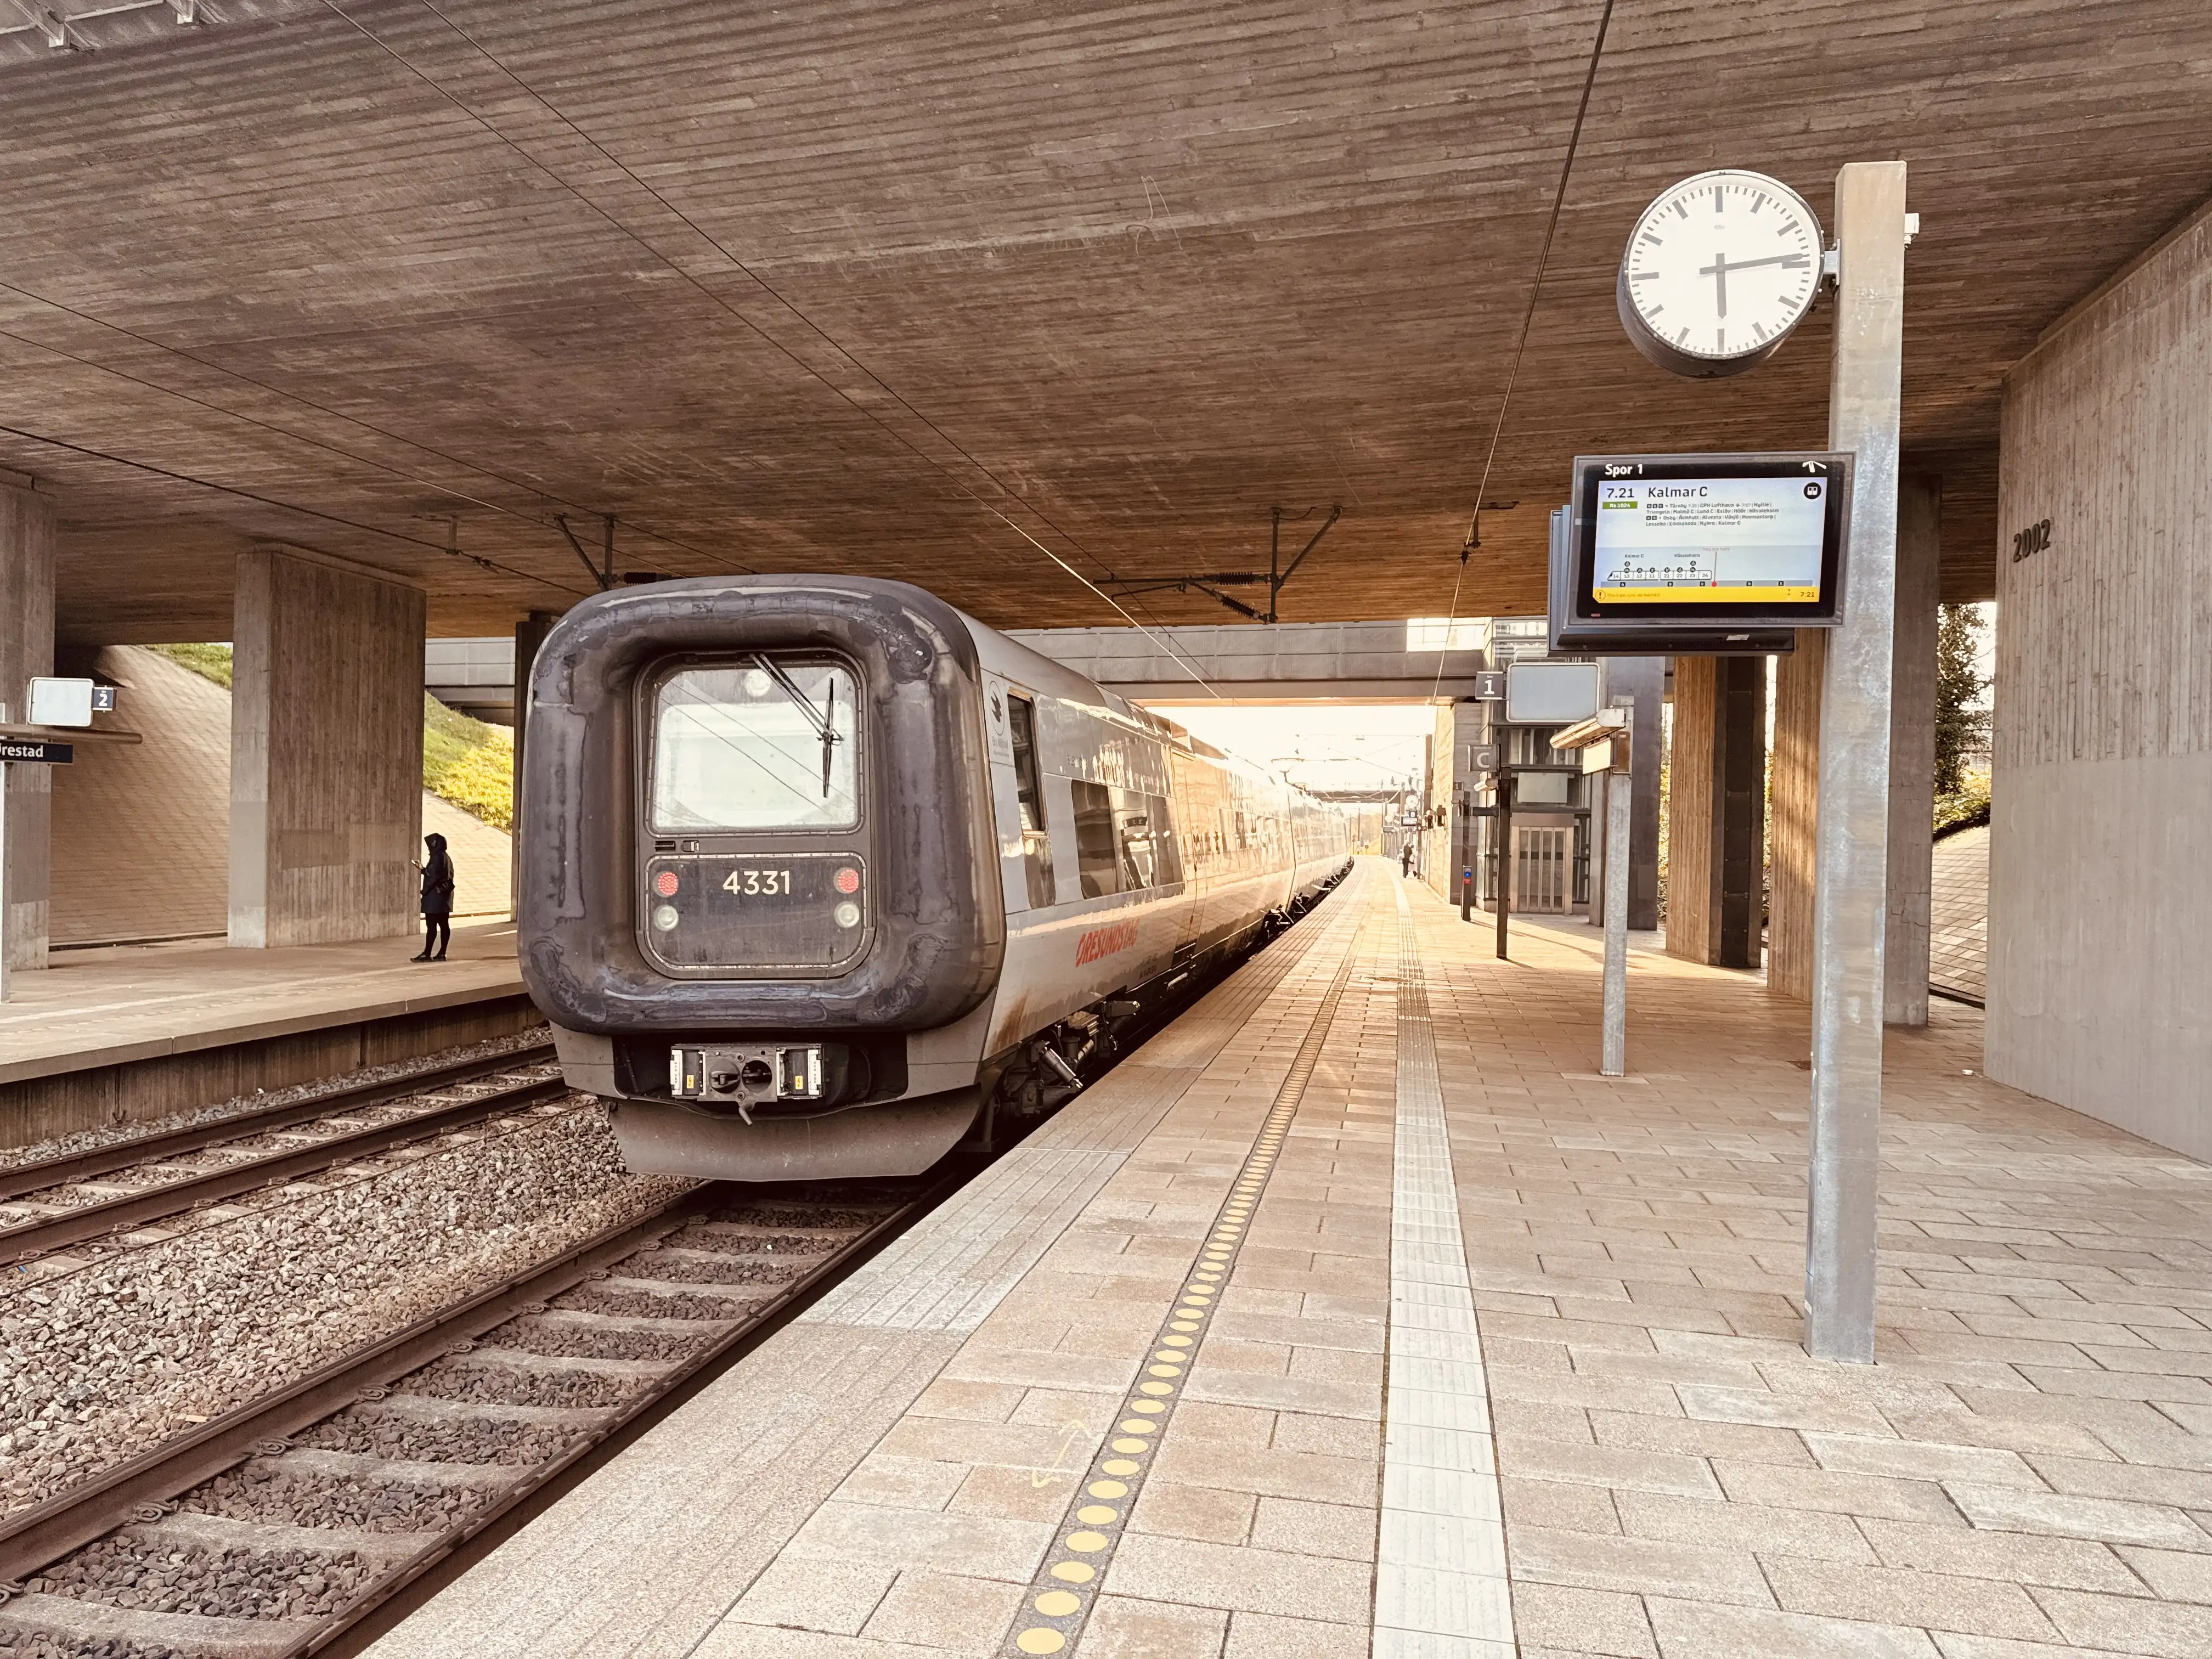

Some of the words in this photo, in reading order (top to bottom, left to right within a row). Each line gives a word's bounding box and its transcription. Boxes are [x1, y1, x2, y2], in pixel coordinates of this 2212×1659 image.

[1605, 464, 1633, 478] Spor
[1638, 464, 1643, 474] 1
[1606, 487, 1635, 498] 7.21
[1648, 487, 1696, 497] Kalmar
[1700, 486, 1708, 497] C
[2013, 519, 2050, 562] 2002
[1484, 680, 1495, 694] 1
[99, 693, 107, 706] 2
[0, 743, 44, 757] restad
[1477, 753, 1490, 768] C
[723, 870, 790, 895] 4331
